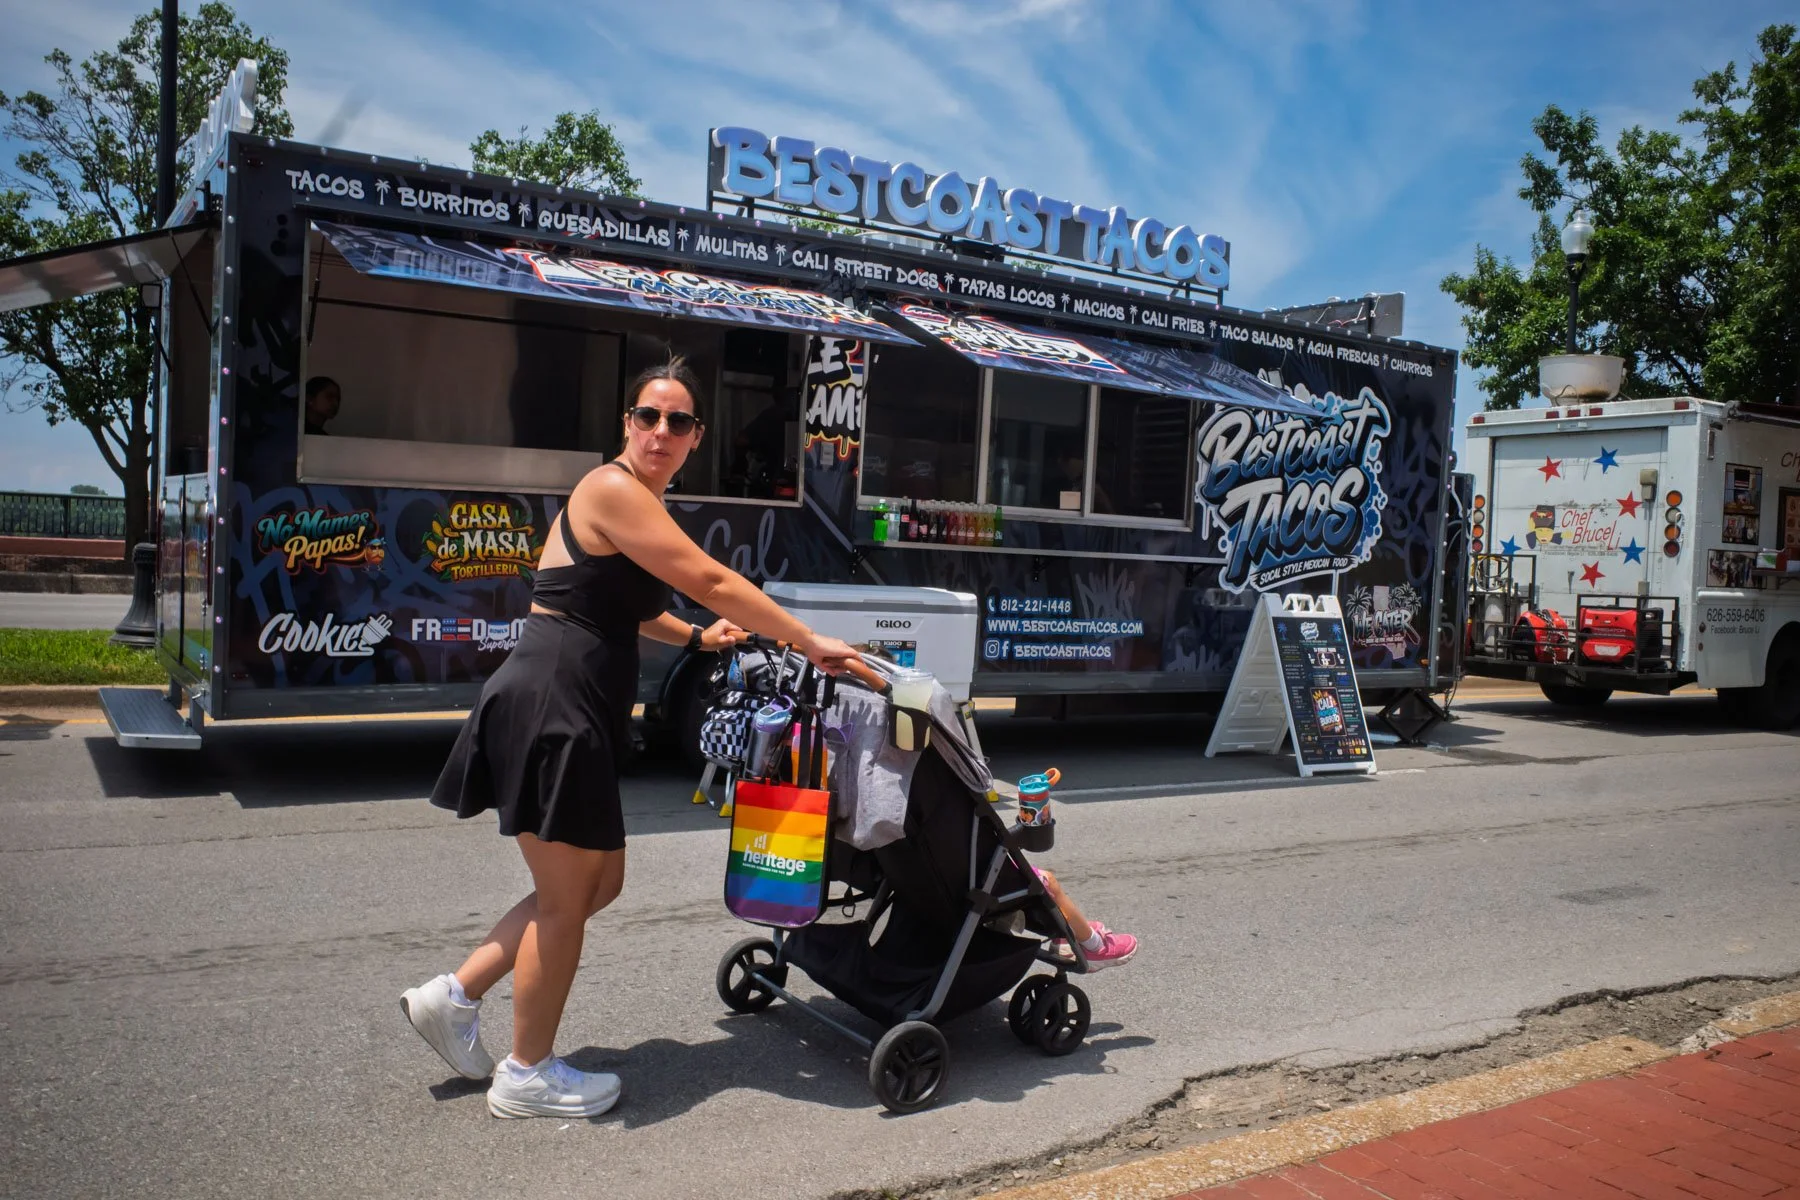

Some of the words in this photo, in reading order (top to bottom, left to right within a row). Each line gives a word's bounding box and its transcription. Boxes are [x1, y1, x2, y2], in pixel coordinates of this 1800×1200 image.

[285, 169, 365, 200] TACOS
[397, 186, 511, 222] BURRITOS
[538, 210, 671, 247] QUESADILLAS
[695, 235, 769, 262] MULITAS
[792, 249, 829, 271] CALI
[834, 256, 892, 283] STREET
[896, 267, 939, 289] DOGS
[959, 276, 1006, 299] PAPAS
[1010, 285, 1056, 309] LOCOS
[1073, 299, 1126, 321] NACHOS
[1141, 310, 1168, 328] CALI
[1172, 316, 1206, 335] FRIES
[1220, 325, 1249, 342] TACO
[1251, 331, 1294, 351] SALADS
[1307, 340, 1334, 358] AGUA
[1337, 347, 1380, 367] FRESCAS
[1390, 358, 1433, 377] CHURROS
[450, 502, 513, 530] CASA
[1561, 507, 1595, 530] Chef
[258, 513, 297, 549] No
[1572, 525, 1611, 544] Bruce
[284, 526, 366, 569] Papas!
[437, 534, 458, 558] de
[458, 529, 531, 562] MASA
[451, 562, 520, 581] TORTILLERIA
[1259, 567, 1282, 586] SOCAL
[1282, 561, 1303, 579] STYLE
[1302, 558, 1330, 574] MEXICAN
[1332, 556, 1348, 568] FOOD
[1000, 599, 1071, 613] 812-221-1448
[1706, 608, 1765, 622] 626-559-6406
[876, 619, 911, 629] IGLOO
[987, 619, 1143, 634] WWW.BESTCOASTTACOS.COM
[1353, 612, 1373, 637] WE
[1375, 609, 1417, 637] CATER
[1014, 644, 1112, 658] BESTCOASTTACOS
[743, 845, 806, 876] heritage
